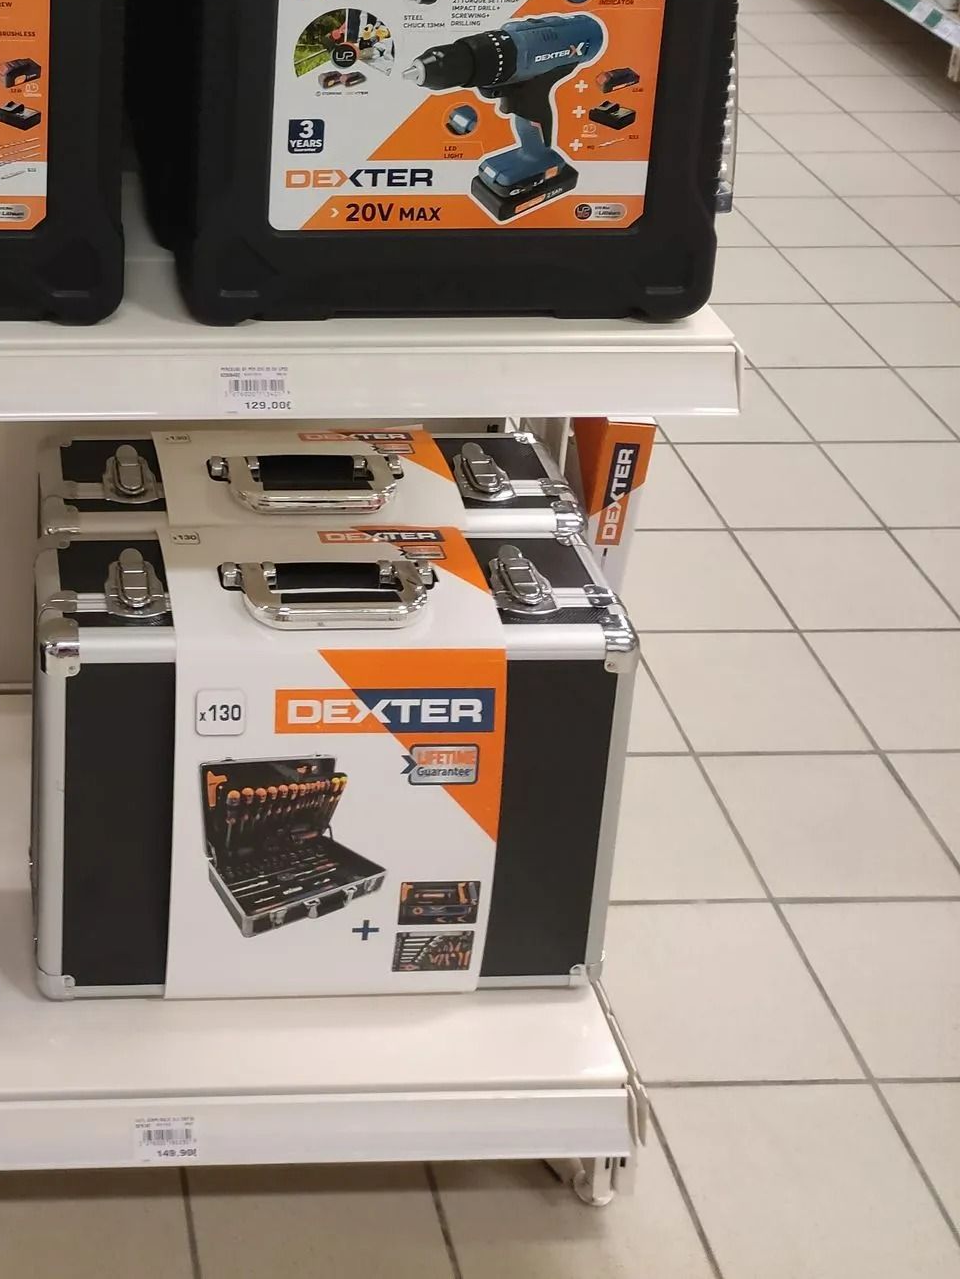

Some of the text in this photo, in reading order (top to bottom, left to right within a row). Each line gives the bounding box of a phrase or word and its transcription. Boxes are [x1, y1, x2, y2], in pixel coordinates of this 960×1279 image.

[298, 119, 314, 139] 3
[290, 139, 322, 148] YEARS
[285, 168, 433, 188] DEXTER
[345, 203, 441, 222] 20V MAX
[304, 432, 409, 441] DEXTER
[601, 448, 635, 540] DEXTER
[325, 531, 437, 541] DEXTER
[199, 704, 242, 722] x130
[287, 698, 483, 724] DEXTER
[416, 749, 475, 765] LIFETIME
[416, 766, 472, 778] Guarantee
